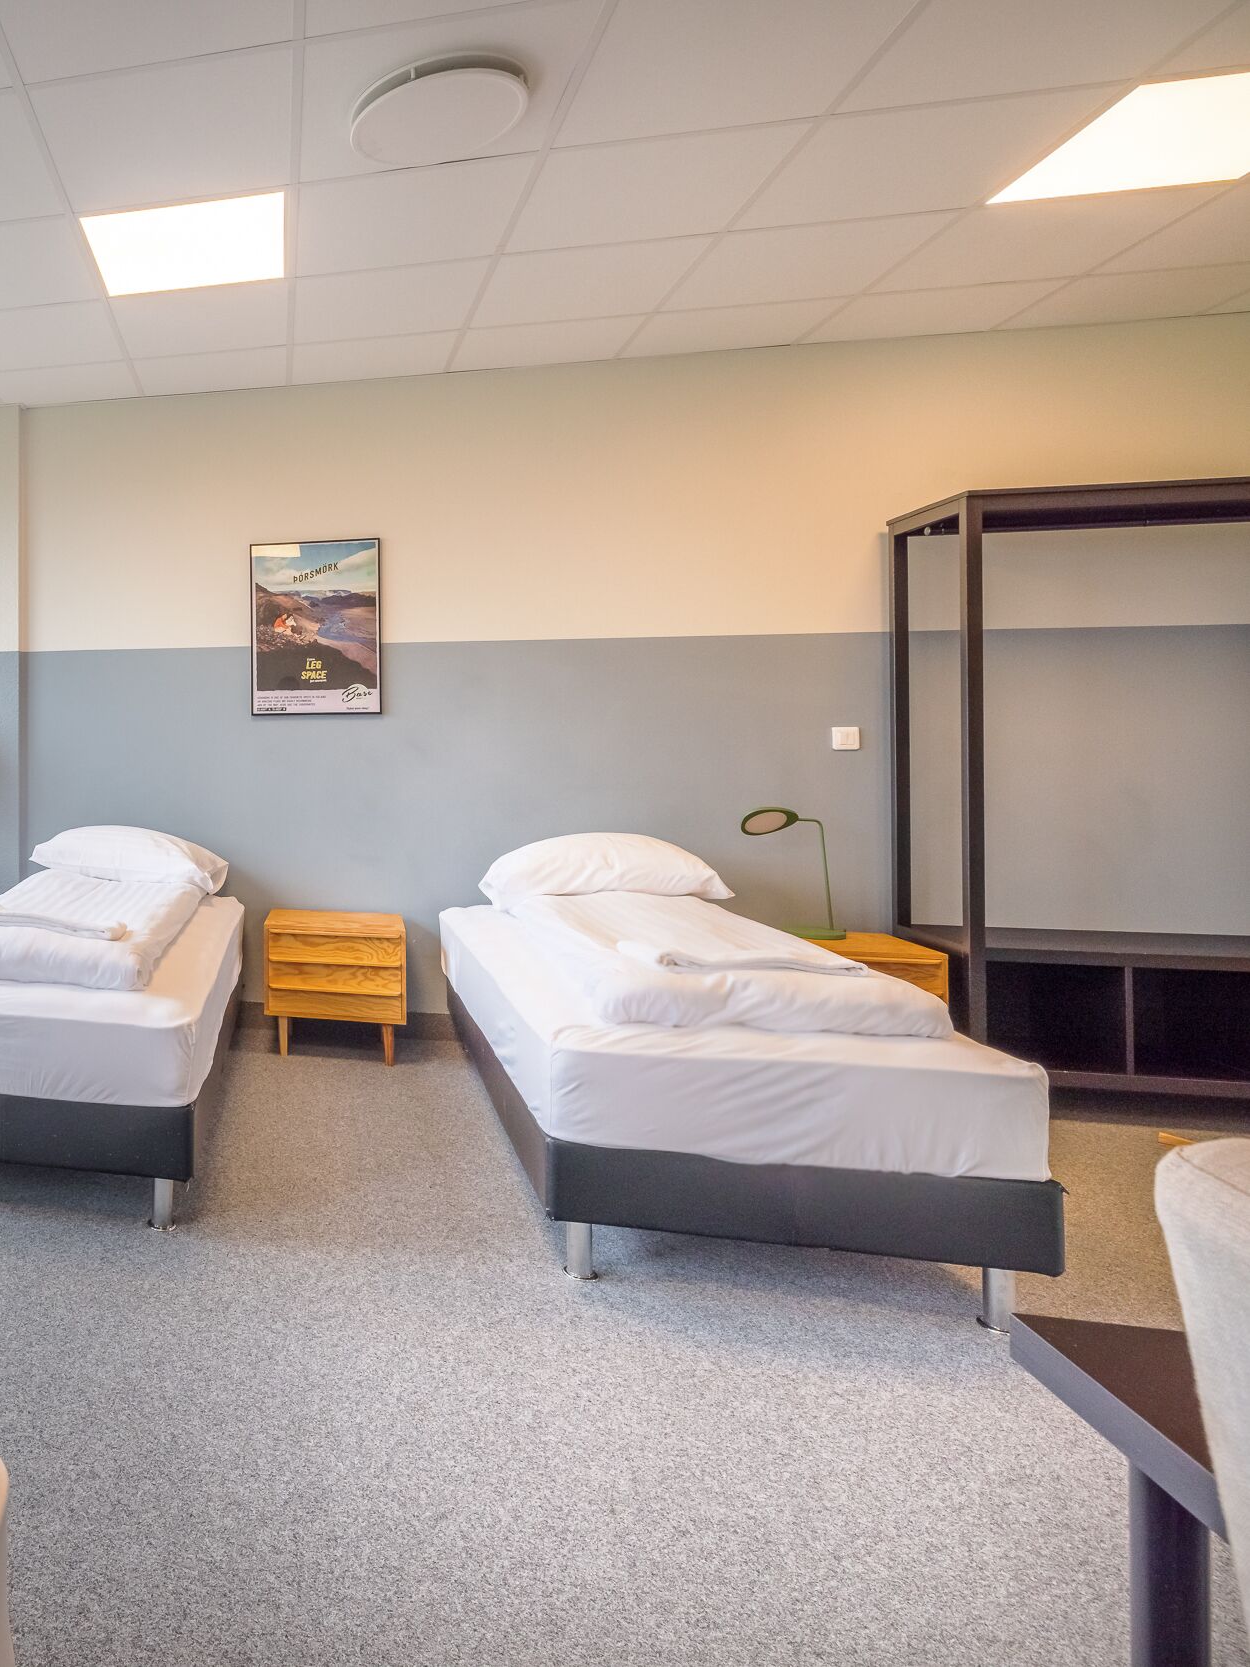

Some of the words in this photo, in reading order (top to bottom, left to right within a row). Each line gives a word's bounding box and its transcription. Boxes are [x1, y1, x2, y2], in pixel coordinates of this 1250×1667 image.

[293, 562, 339, 583] ÞÓRSMÖRK
[306, 661, 322, 669] LEG
[301, 670, 327, 679] SPACE
[342, 686, 373, 703] Base
